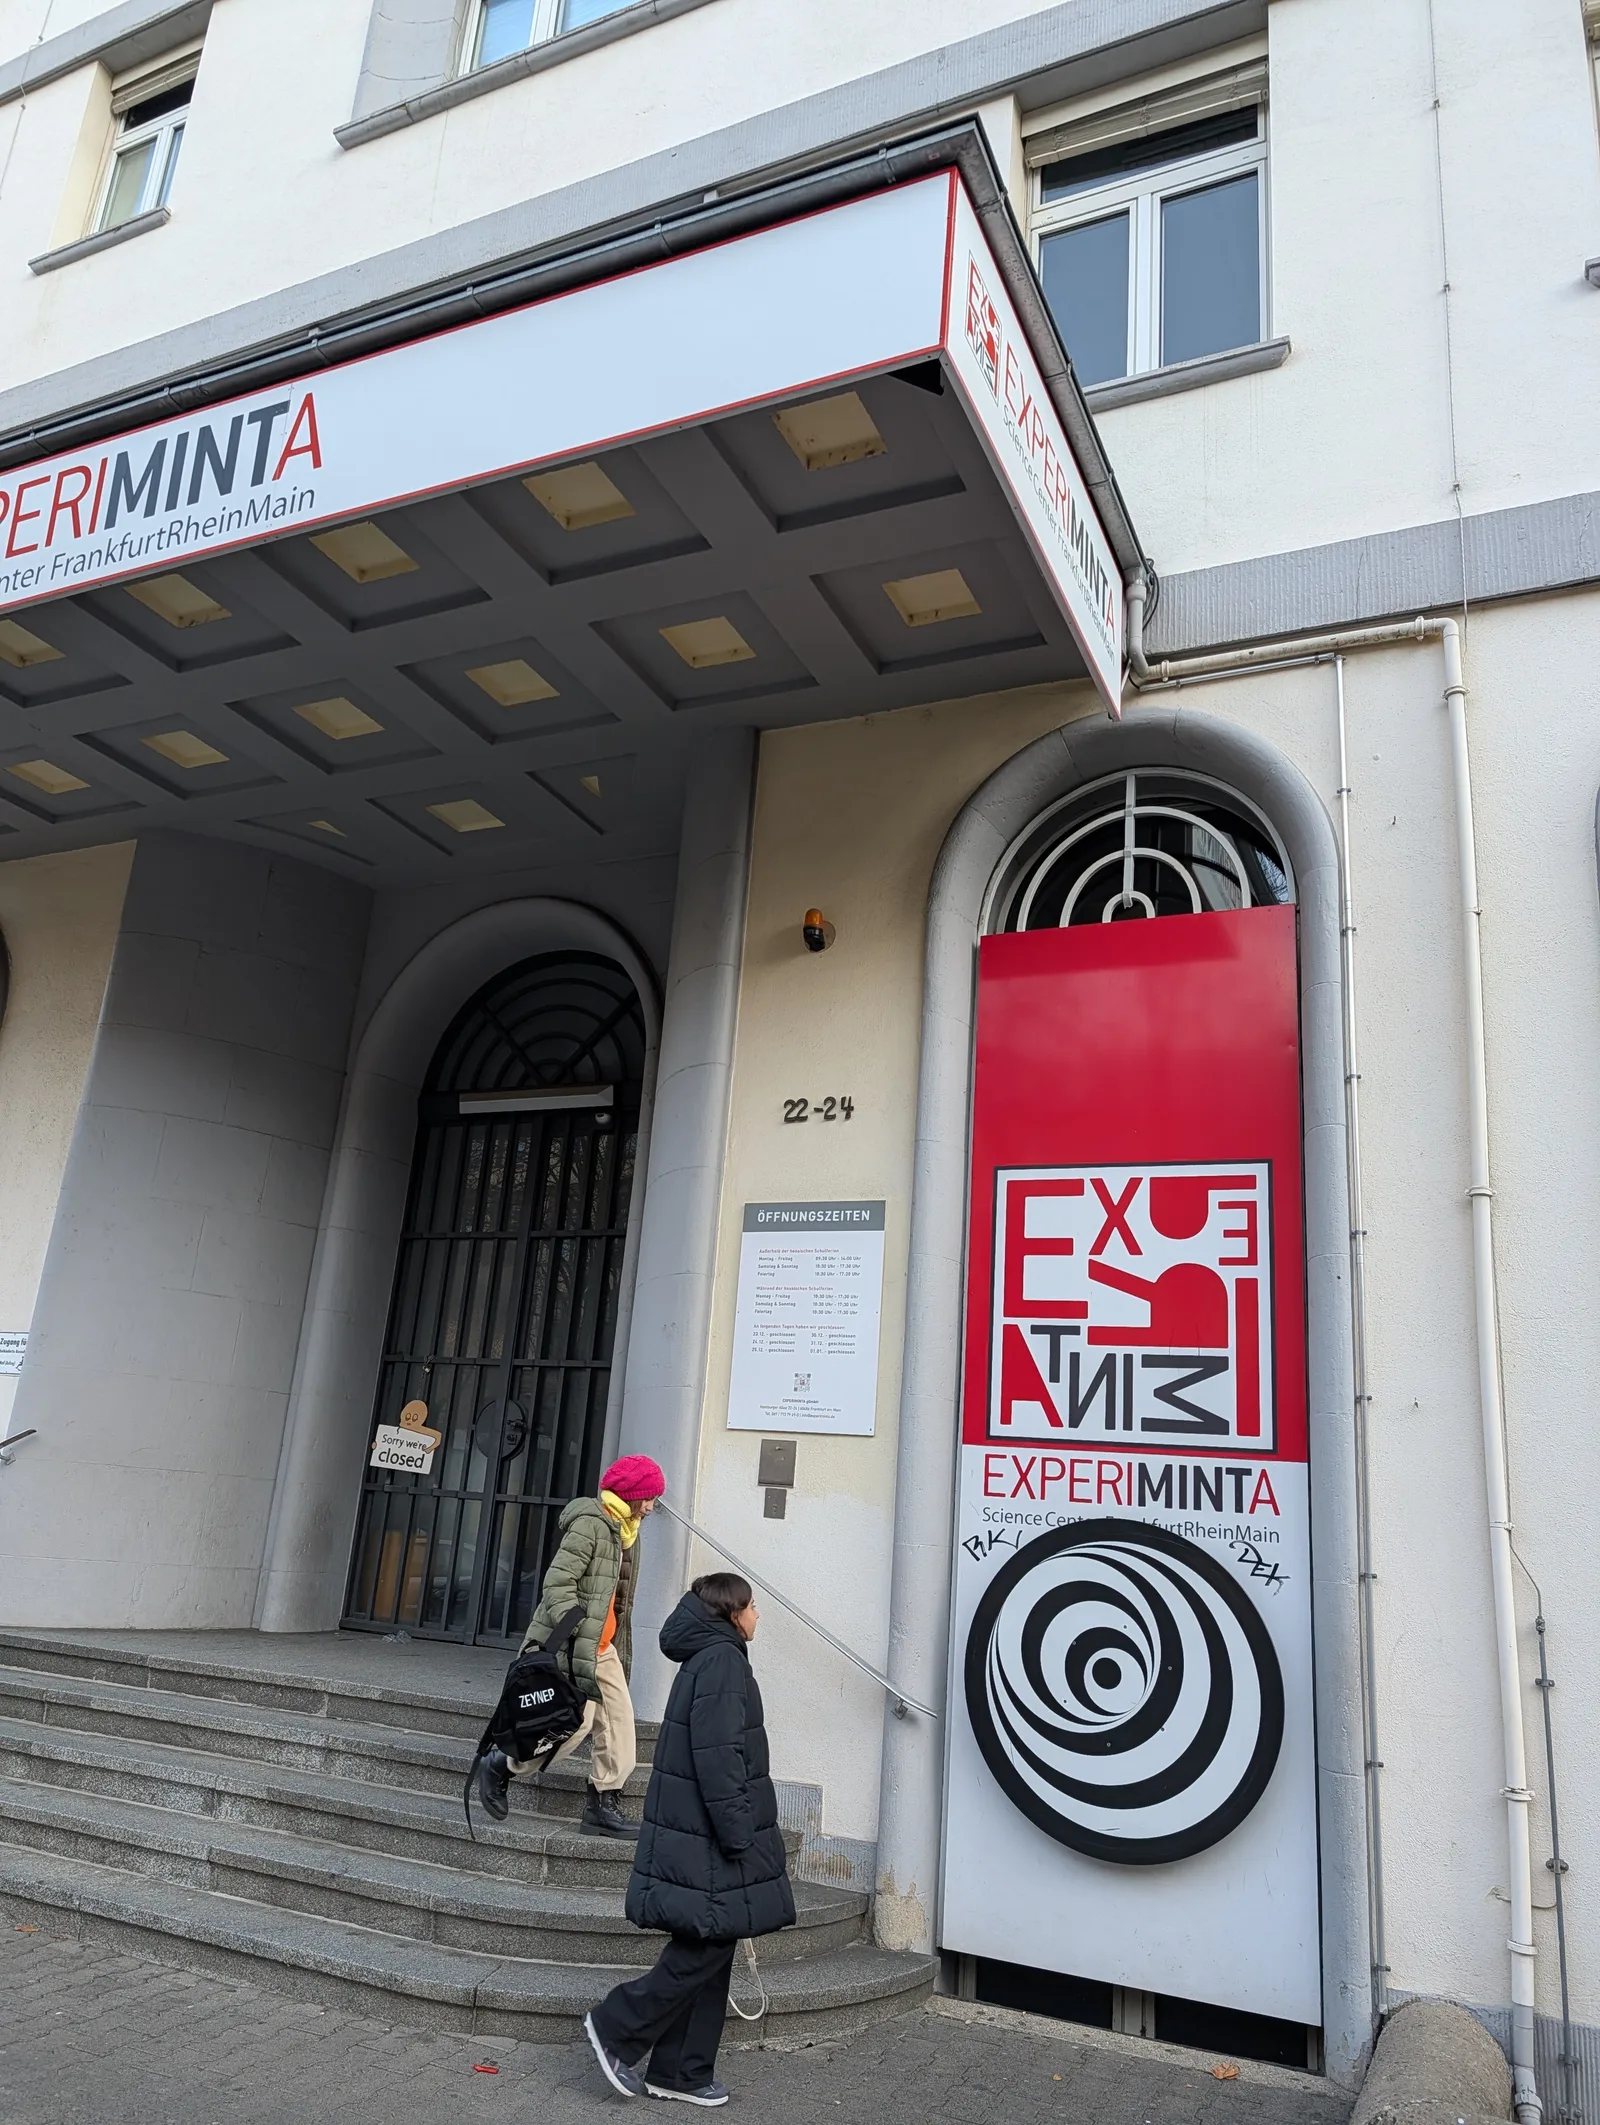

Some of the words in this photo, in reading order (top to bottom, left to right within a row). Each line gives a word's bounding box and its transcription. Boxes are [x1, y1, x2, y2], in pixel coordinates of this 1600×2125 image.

[1003, 404, 1033, 479] Science
[1033, 474, 1057, 533] Center
[1005, 340, 1116, 644] EXPERIMINTA
[50, 486, 315, 581] FrankfurtRheinMain
[783, 1096, 855, 1123] 22-24
[757, 1209, 870, 1223] ÖFFNUNGSZEITEN
[0, 1337, 20, 1347] Zugang
[381, 1434, 405, 1448] Sorry
[405, 1440, 427, 1452] we're
[378, 1448, 426, 1469] closed
[983, 1453, 1281, 1516] EXPERIMINTA
[982, 1506, 1042, 1526] Science
[518, 1687, 555, 1709] ZEYNEP
